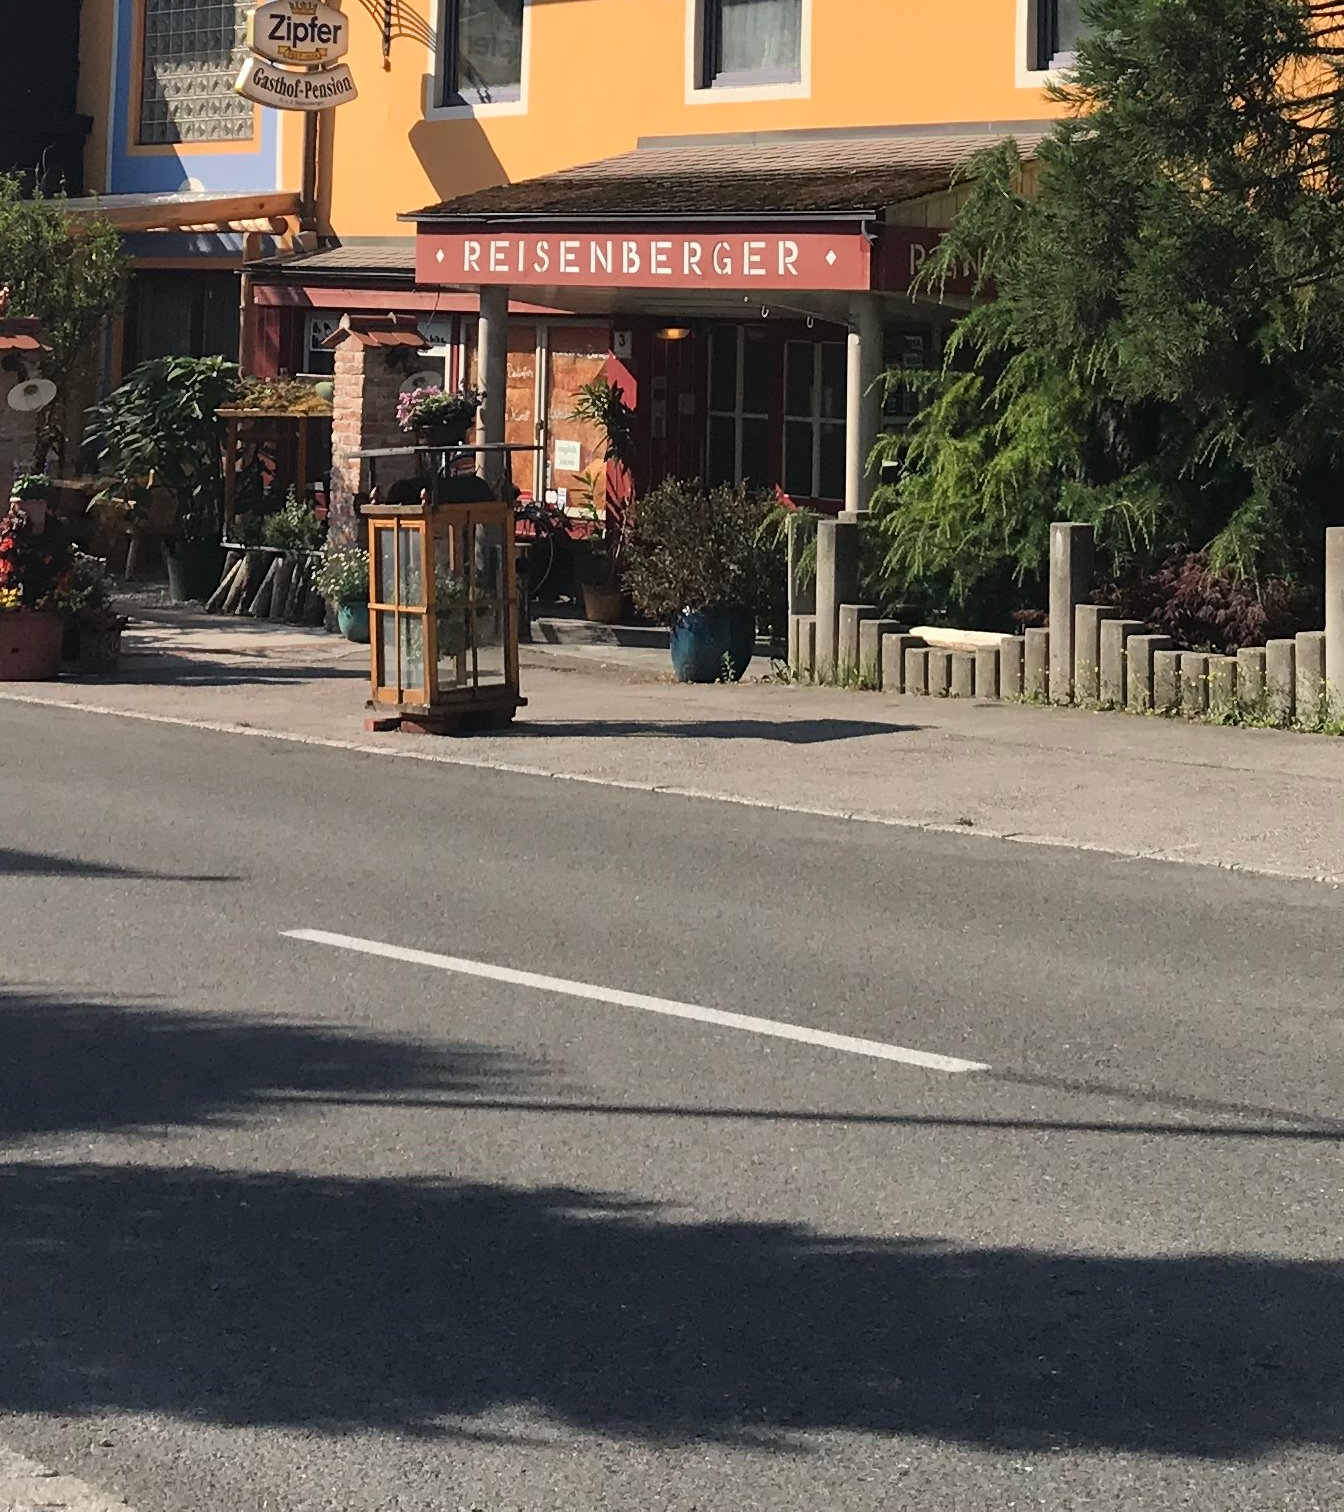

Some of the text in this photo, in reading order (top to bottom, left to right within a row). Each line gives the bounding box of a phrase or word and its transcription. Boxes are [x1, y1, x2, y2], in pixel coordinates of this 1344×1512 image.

[267, 13, 343, 49] Zipfer
[252, 67, 353, 100] Gasthof-Pension
[462, 238, 801, 277] REISENBERGER
